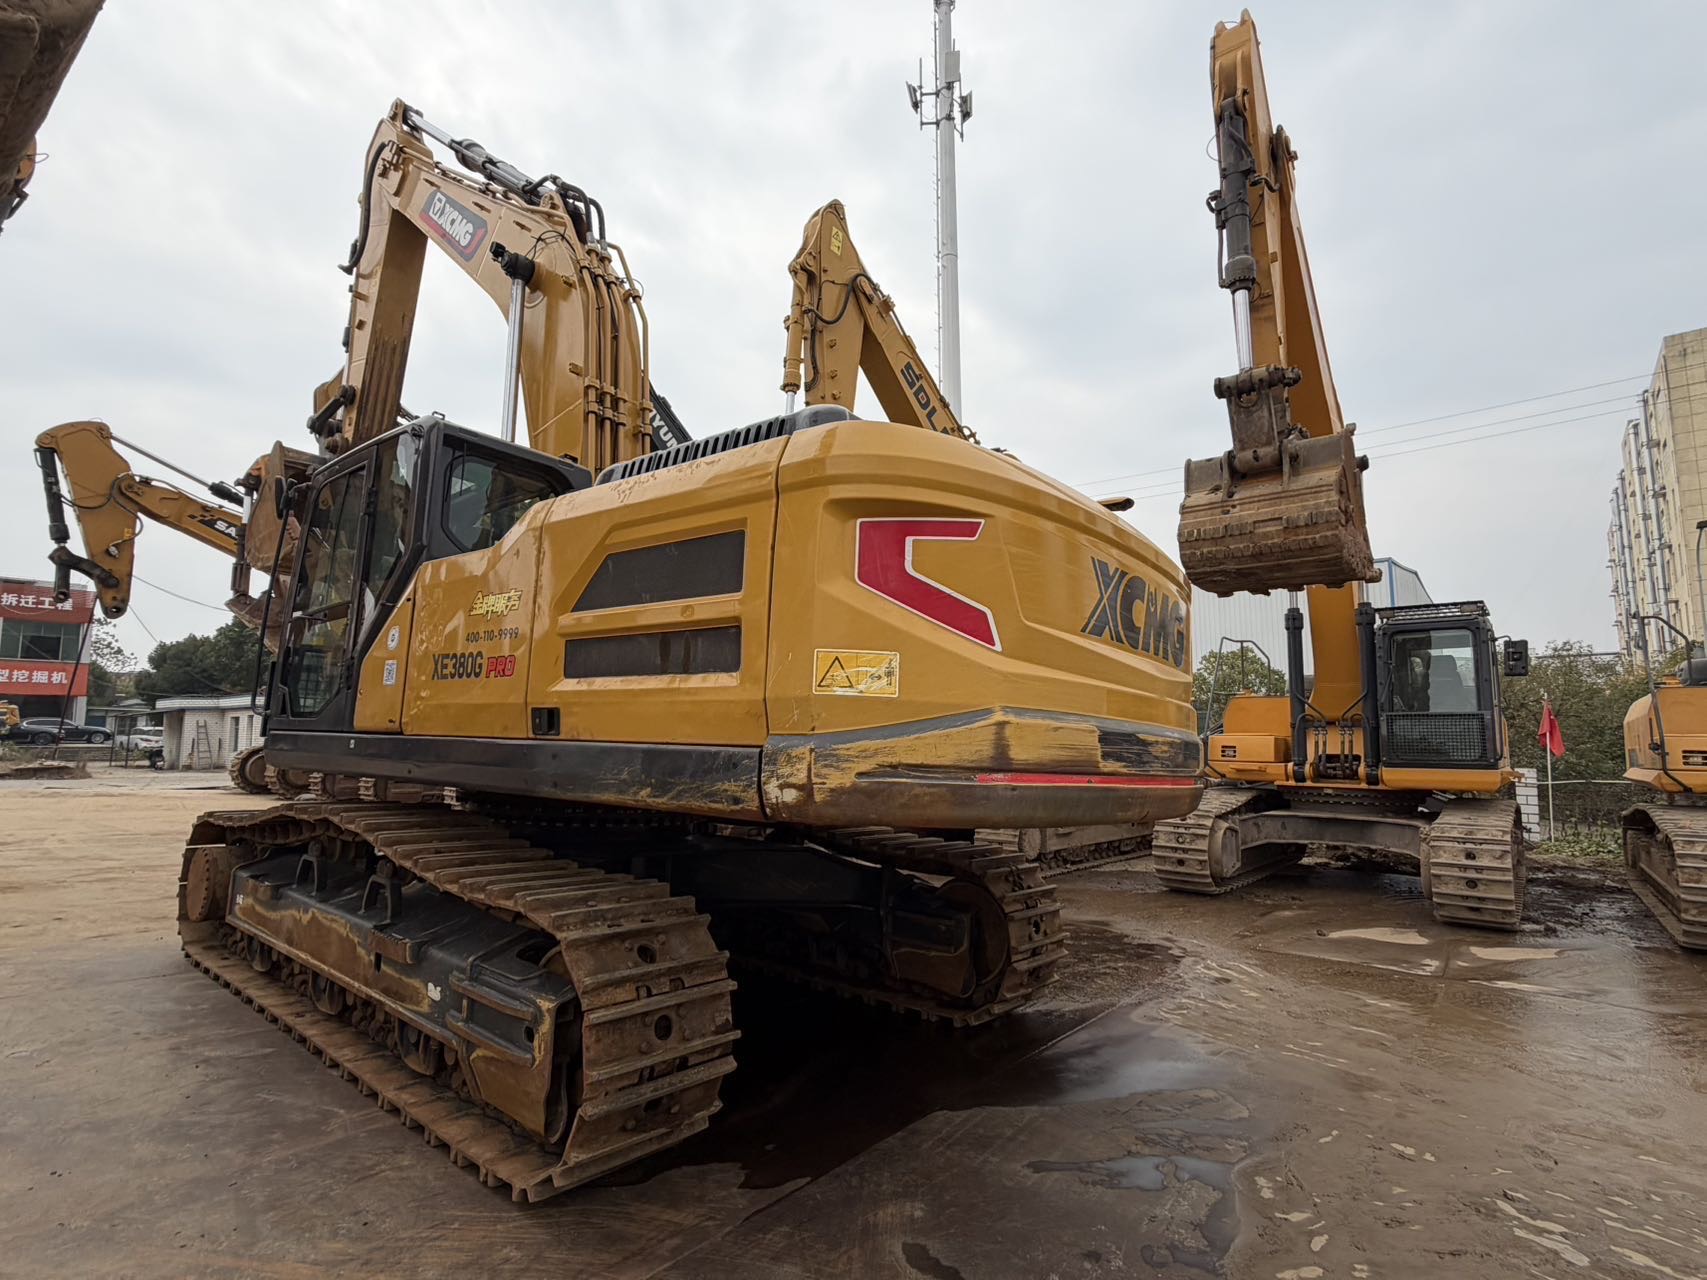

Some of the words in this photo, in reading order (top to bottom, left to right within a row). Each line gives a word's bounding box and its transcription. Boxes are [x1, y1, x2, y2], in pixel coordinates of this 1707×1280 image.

[439, 203, 474, 247] XCMG
[900, 361, 950, 435] SDL
[1081, 556, 1185, 668] XCMG
[465, 627, 519, 643] 400-110-9999
[432, 651, 483, 680] XE380G
[485, 654, 516, 678] PRO
